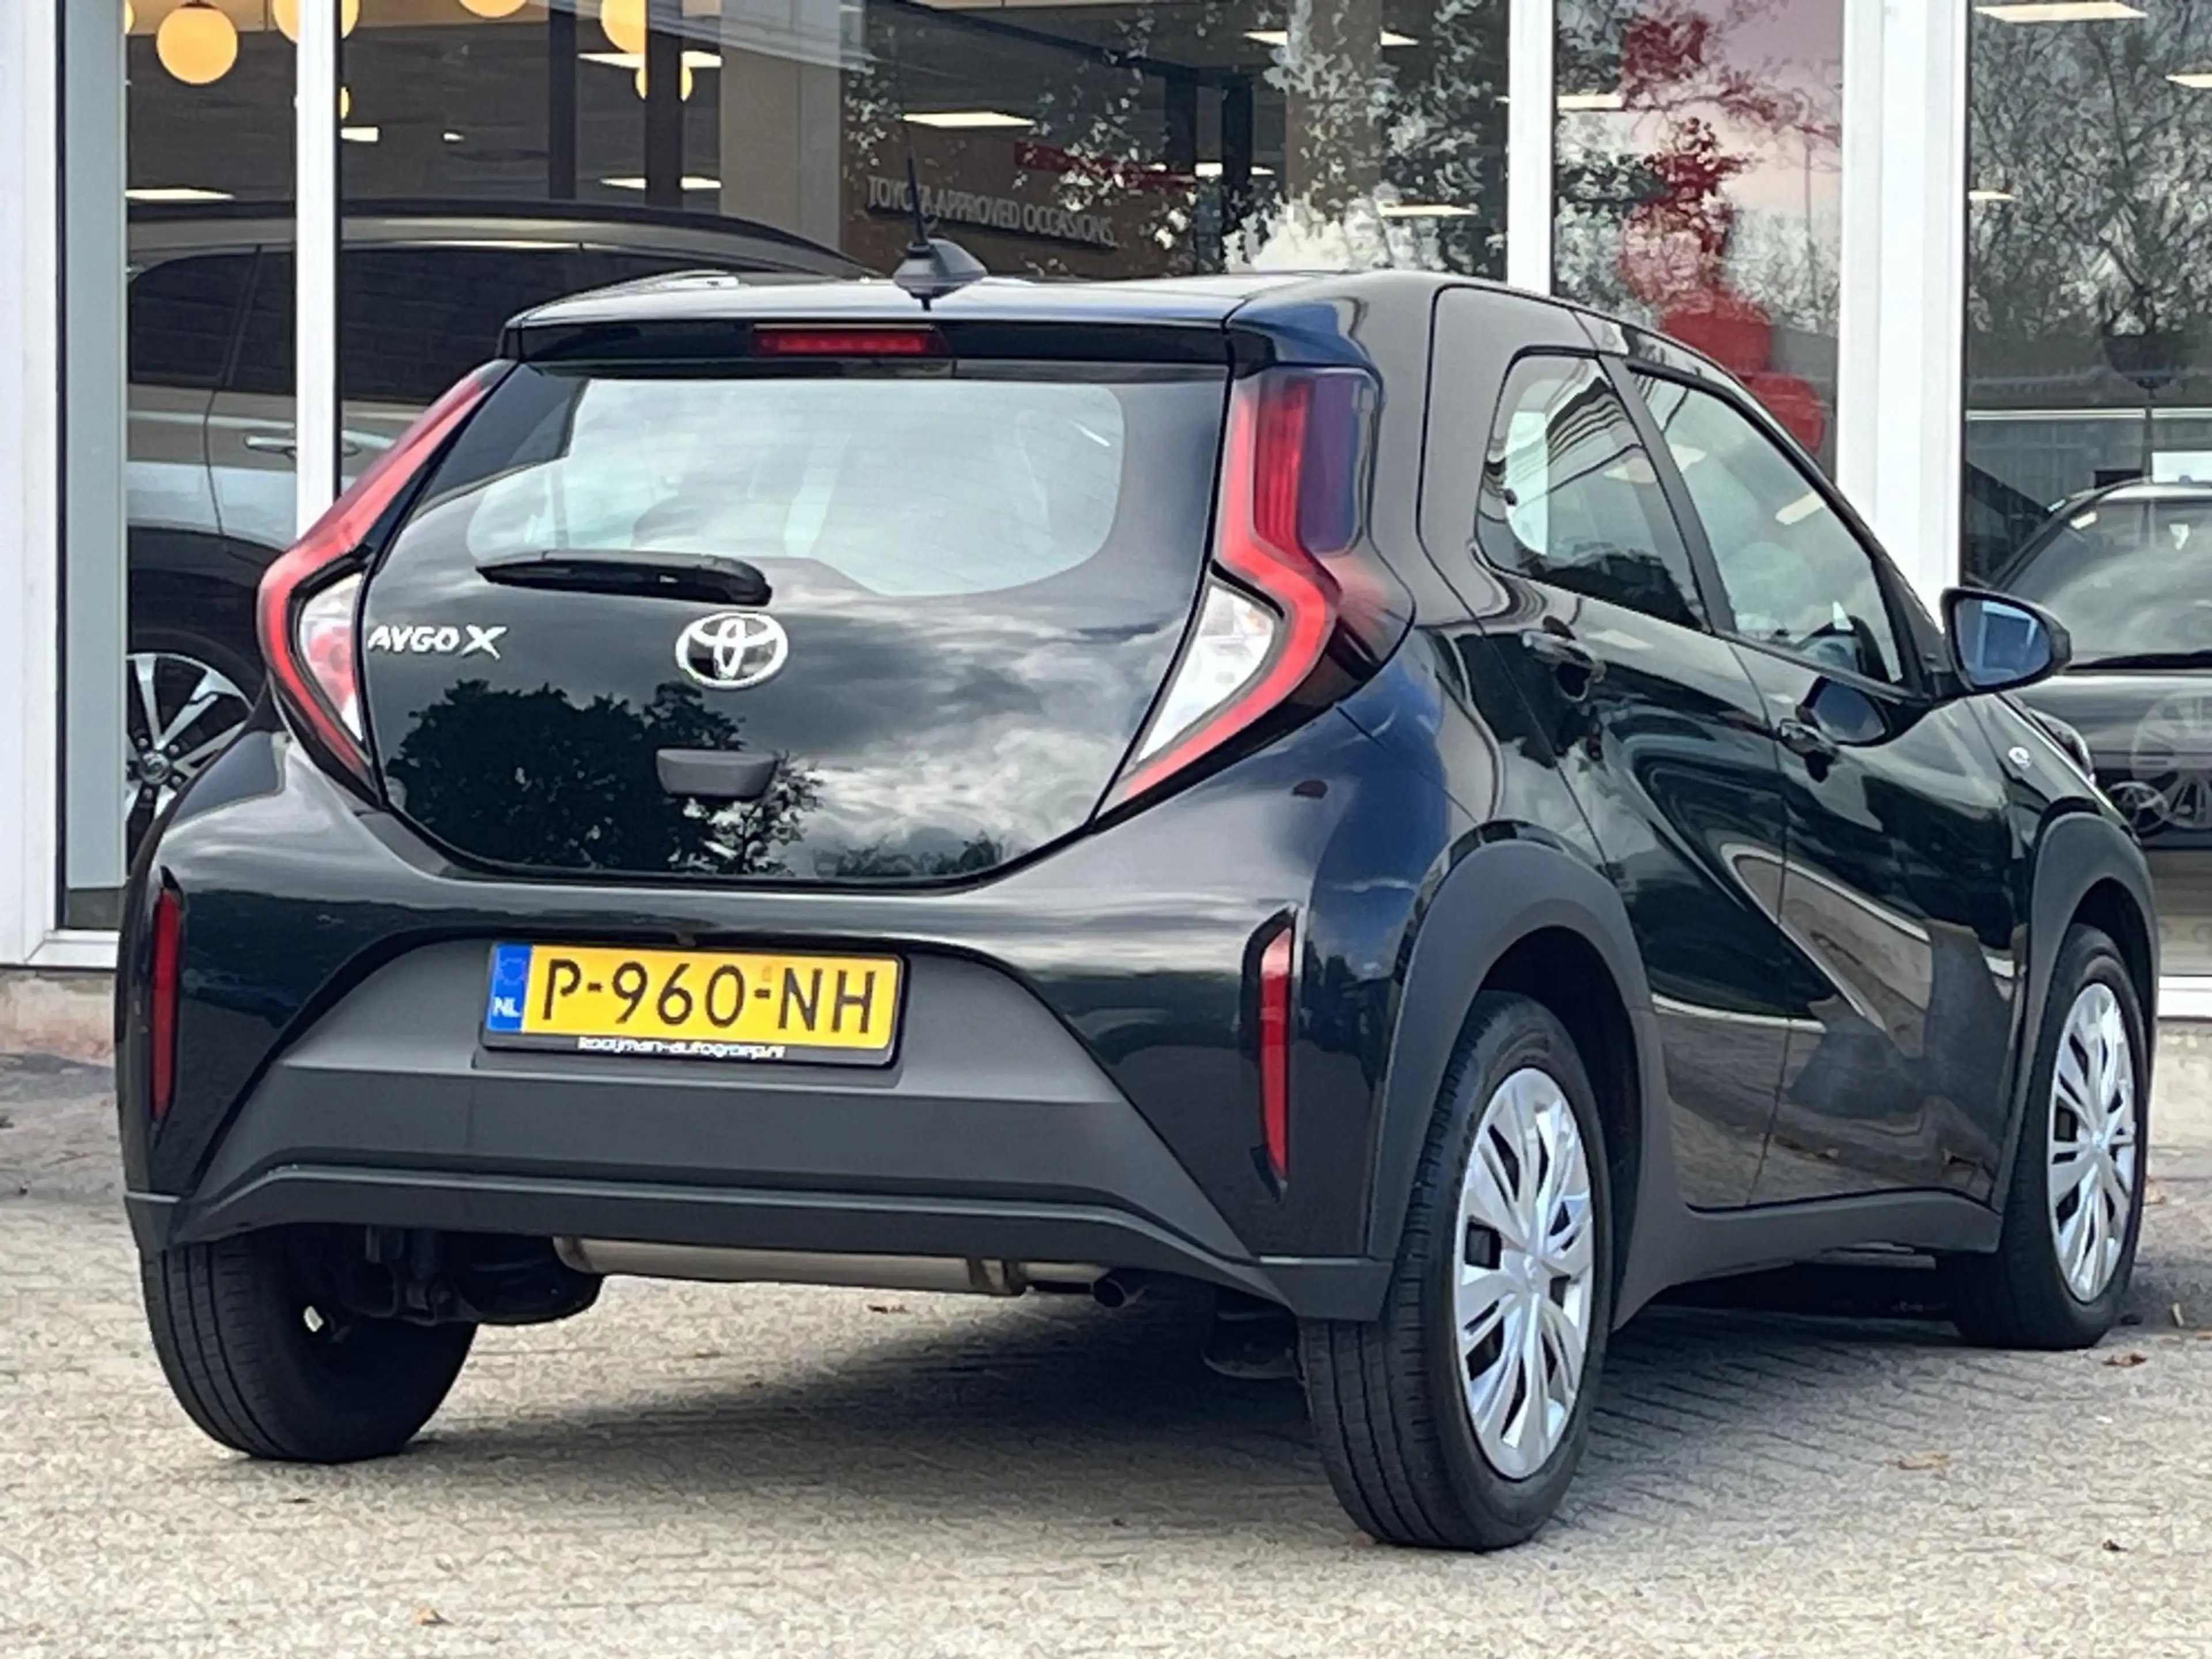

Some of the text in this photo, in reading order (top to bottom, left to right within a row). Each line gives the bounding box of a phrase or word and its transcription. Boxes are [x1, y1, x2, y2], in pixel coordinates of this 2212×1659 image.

[935, 189, 1020, 229] APPROVED
[1024, 203, 1116, 247] OCCASIONS
[368, 624, 507, 660] AYGO X
[492, 995, 521, 1018] NL
[542, 958, 877, 1035] P-960-NH
